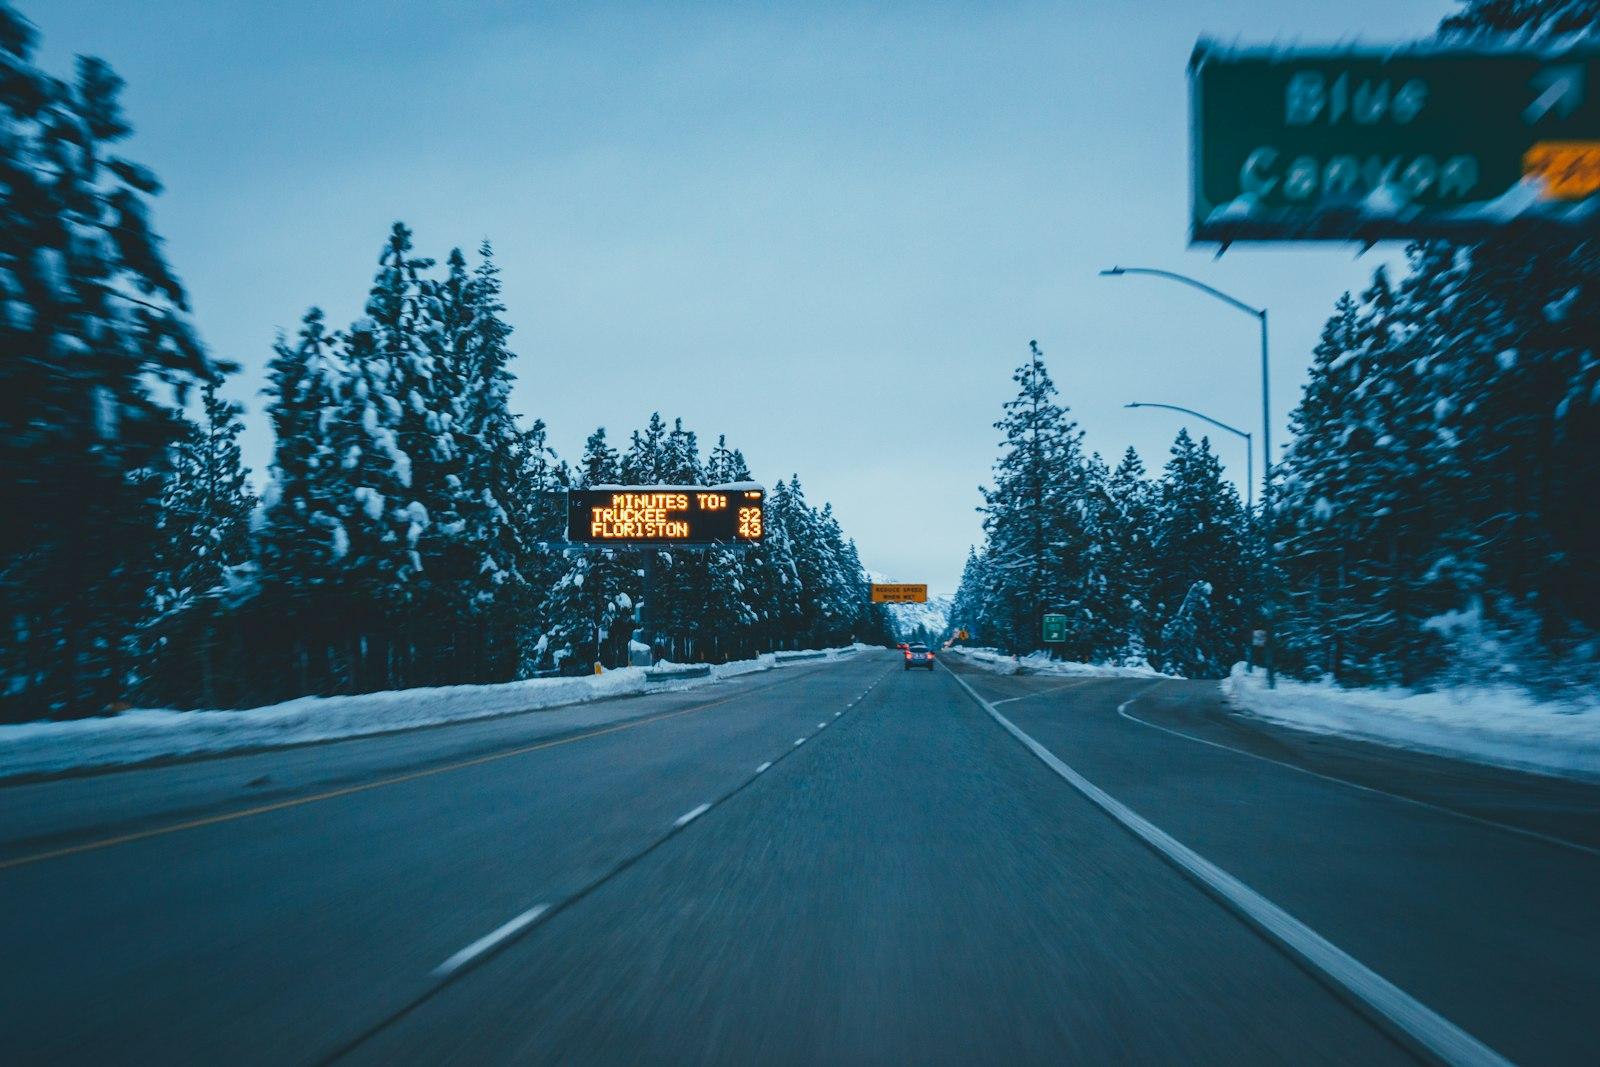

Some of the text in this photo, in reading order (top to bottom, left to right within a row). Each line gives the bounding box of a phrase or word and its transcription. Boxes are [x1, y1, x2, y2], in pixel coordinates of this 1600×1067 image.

[1284, 70, 1429, 126] Blue
[612, 493, 728, 509] MINUTES TO:
[592, 508, 762, 523] TRUCKEE 32
[591, 522, 762, 538] FLORISTON 43
